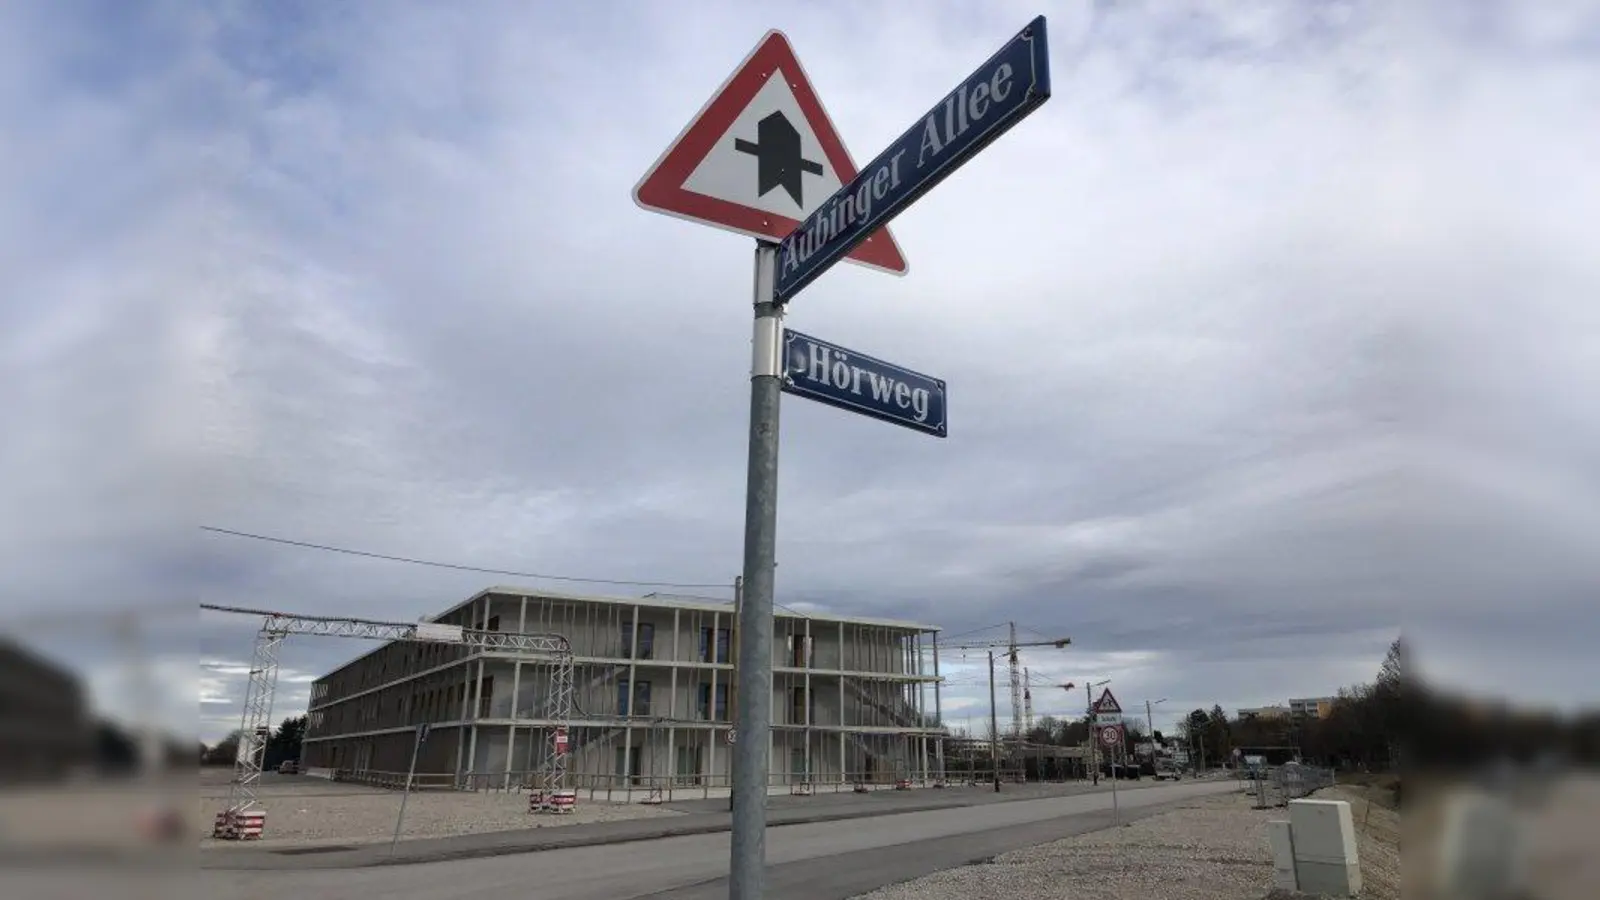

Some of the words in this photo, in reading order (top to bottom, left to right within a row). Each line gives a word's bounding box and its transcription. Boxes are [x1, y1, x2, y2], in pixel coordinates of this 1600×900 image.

[779, 148, 905, 280] Aubinger
[916, 61, 1013, 168] Allee
[806, 341, 930, 422] Hörweg
[1104, 730, 1116, 740] 30
